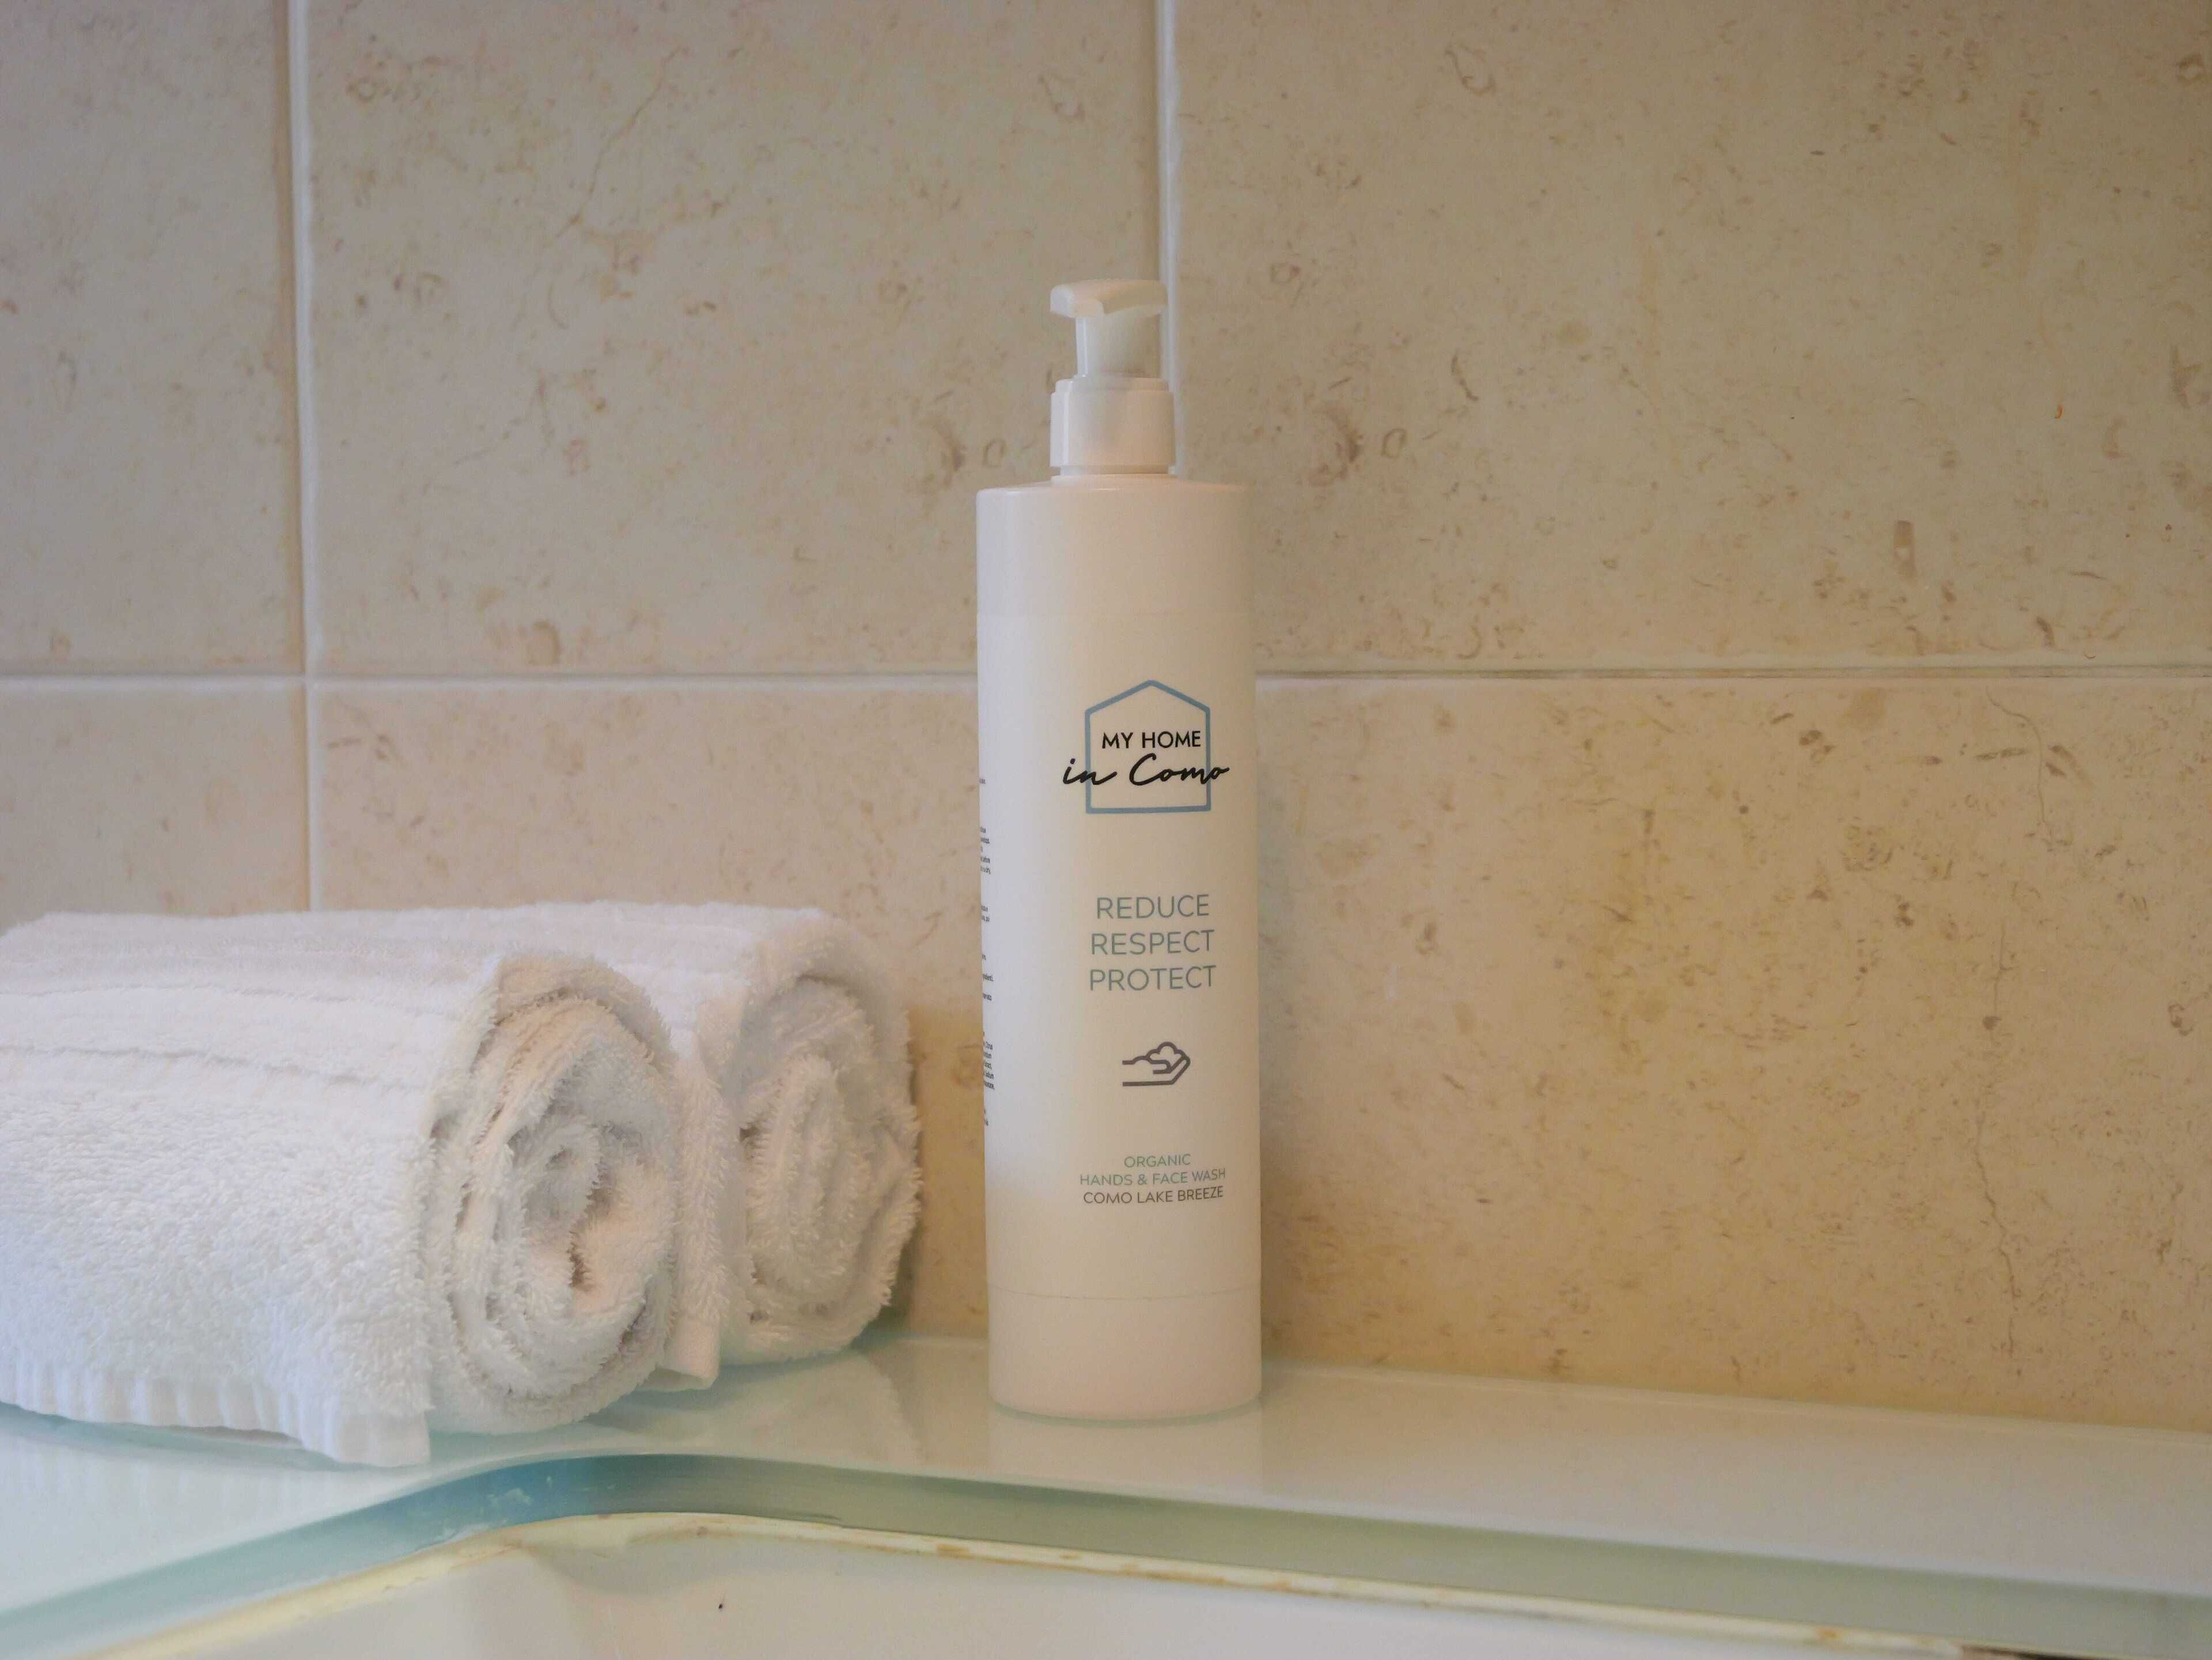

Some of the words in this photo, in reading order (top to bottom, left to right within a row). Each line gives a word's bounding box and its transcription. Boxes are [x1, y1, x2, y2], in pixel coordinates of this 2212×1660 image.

[1102, 733, 1133, 748] MY
[1142, 731, 1200, 748] HOME
[1063, 759, 1117, 785] in
[1129, 753, 1229, 786] Como
[1097, 894, 1209, 919] REDUCE
[1092, 930, 1214, 954] RESPECT
[1090, 965, 1216, 991] PROTECT
[1124, 1154, 1190, 1168] ORGANIC
[1081, 1174, 1132, 1185] HANDS
[1138, 1174, 1147, 1185] &
[1153, 1172, 1187, 1184] FACE
[1192, 1169, 1225, 1181] WASH
[1084, 1192, 1132, 1203] COMO
[1138, 1191, 1172, 1203] LAKE
[1178, 1186, 1223, 1201] BREEZE
